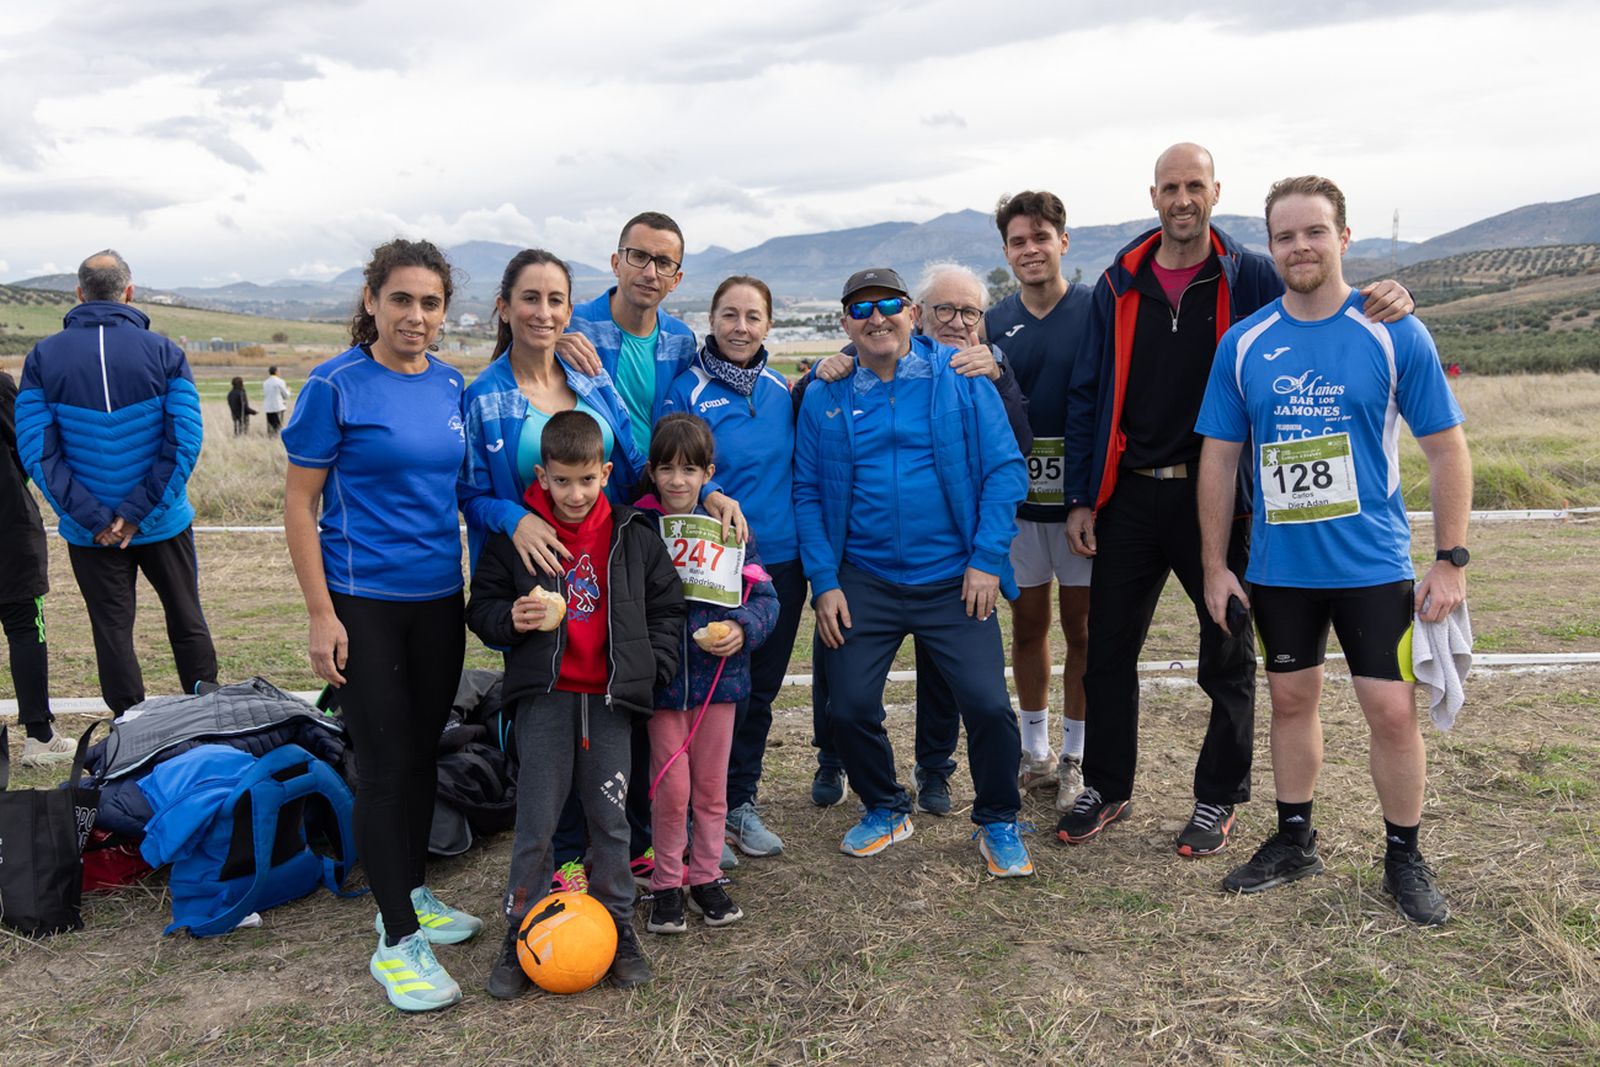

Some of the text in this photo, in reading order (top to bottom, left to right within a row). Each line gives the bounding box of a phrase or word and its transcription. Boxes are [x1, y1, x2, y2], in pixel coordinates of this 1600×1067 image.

[1272, 369, 1346, 396] Mañas
[1273, 405, 1340, 417] JAMONES
[1289, 396, 1314, 405] BAR
[1028, 457, 1061, 480] 95
[1272, 460, 1333, 494] 128
[672, 538, 725, 572] 247
